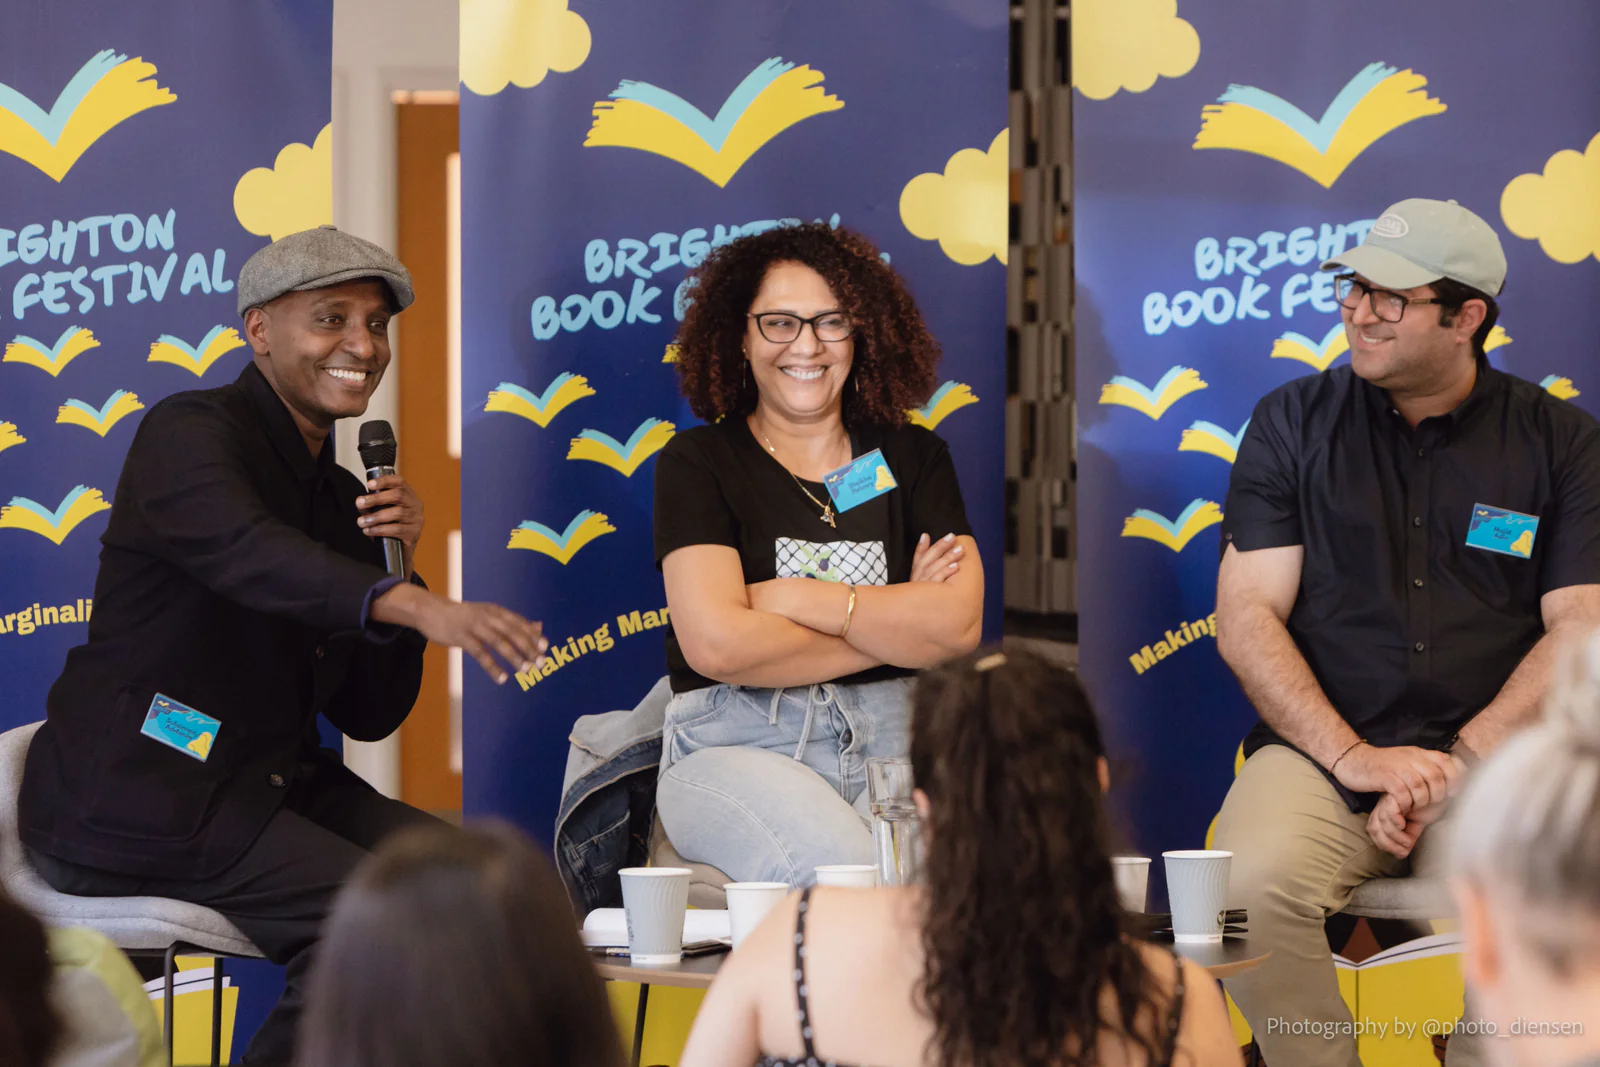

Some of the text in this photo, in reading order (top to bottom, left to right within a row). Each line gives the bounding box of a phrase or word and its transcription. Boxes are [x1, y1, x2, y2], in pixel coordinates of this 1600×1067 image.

[0, 208, 176, 267] IGHTON
[1195, 218, 1378, 280] BRIGHT
[12, 248, 235, 320] FESTIVAL
[530, 278, 662, 340] BOOK
[1142, 275, 1271, 336] BOOK
[514, 623, 615, 692] Making
